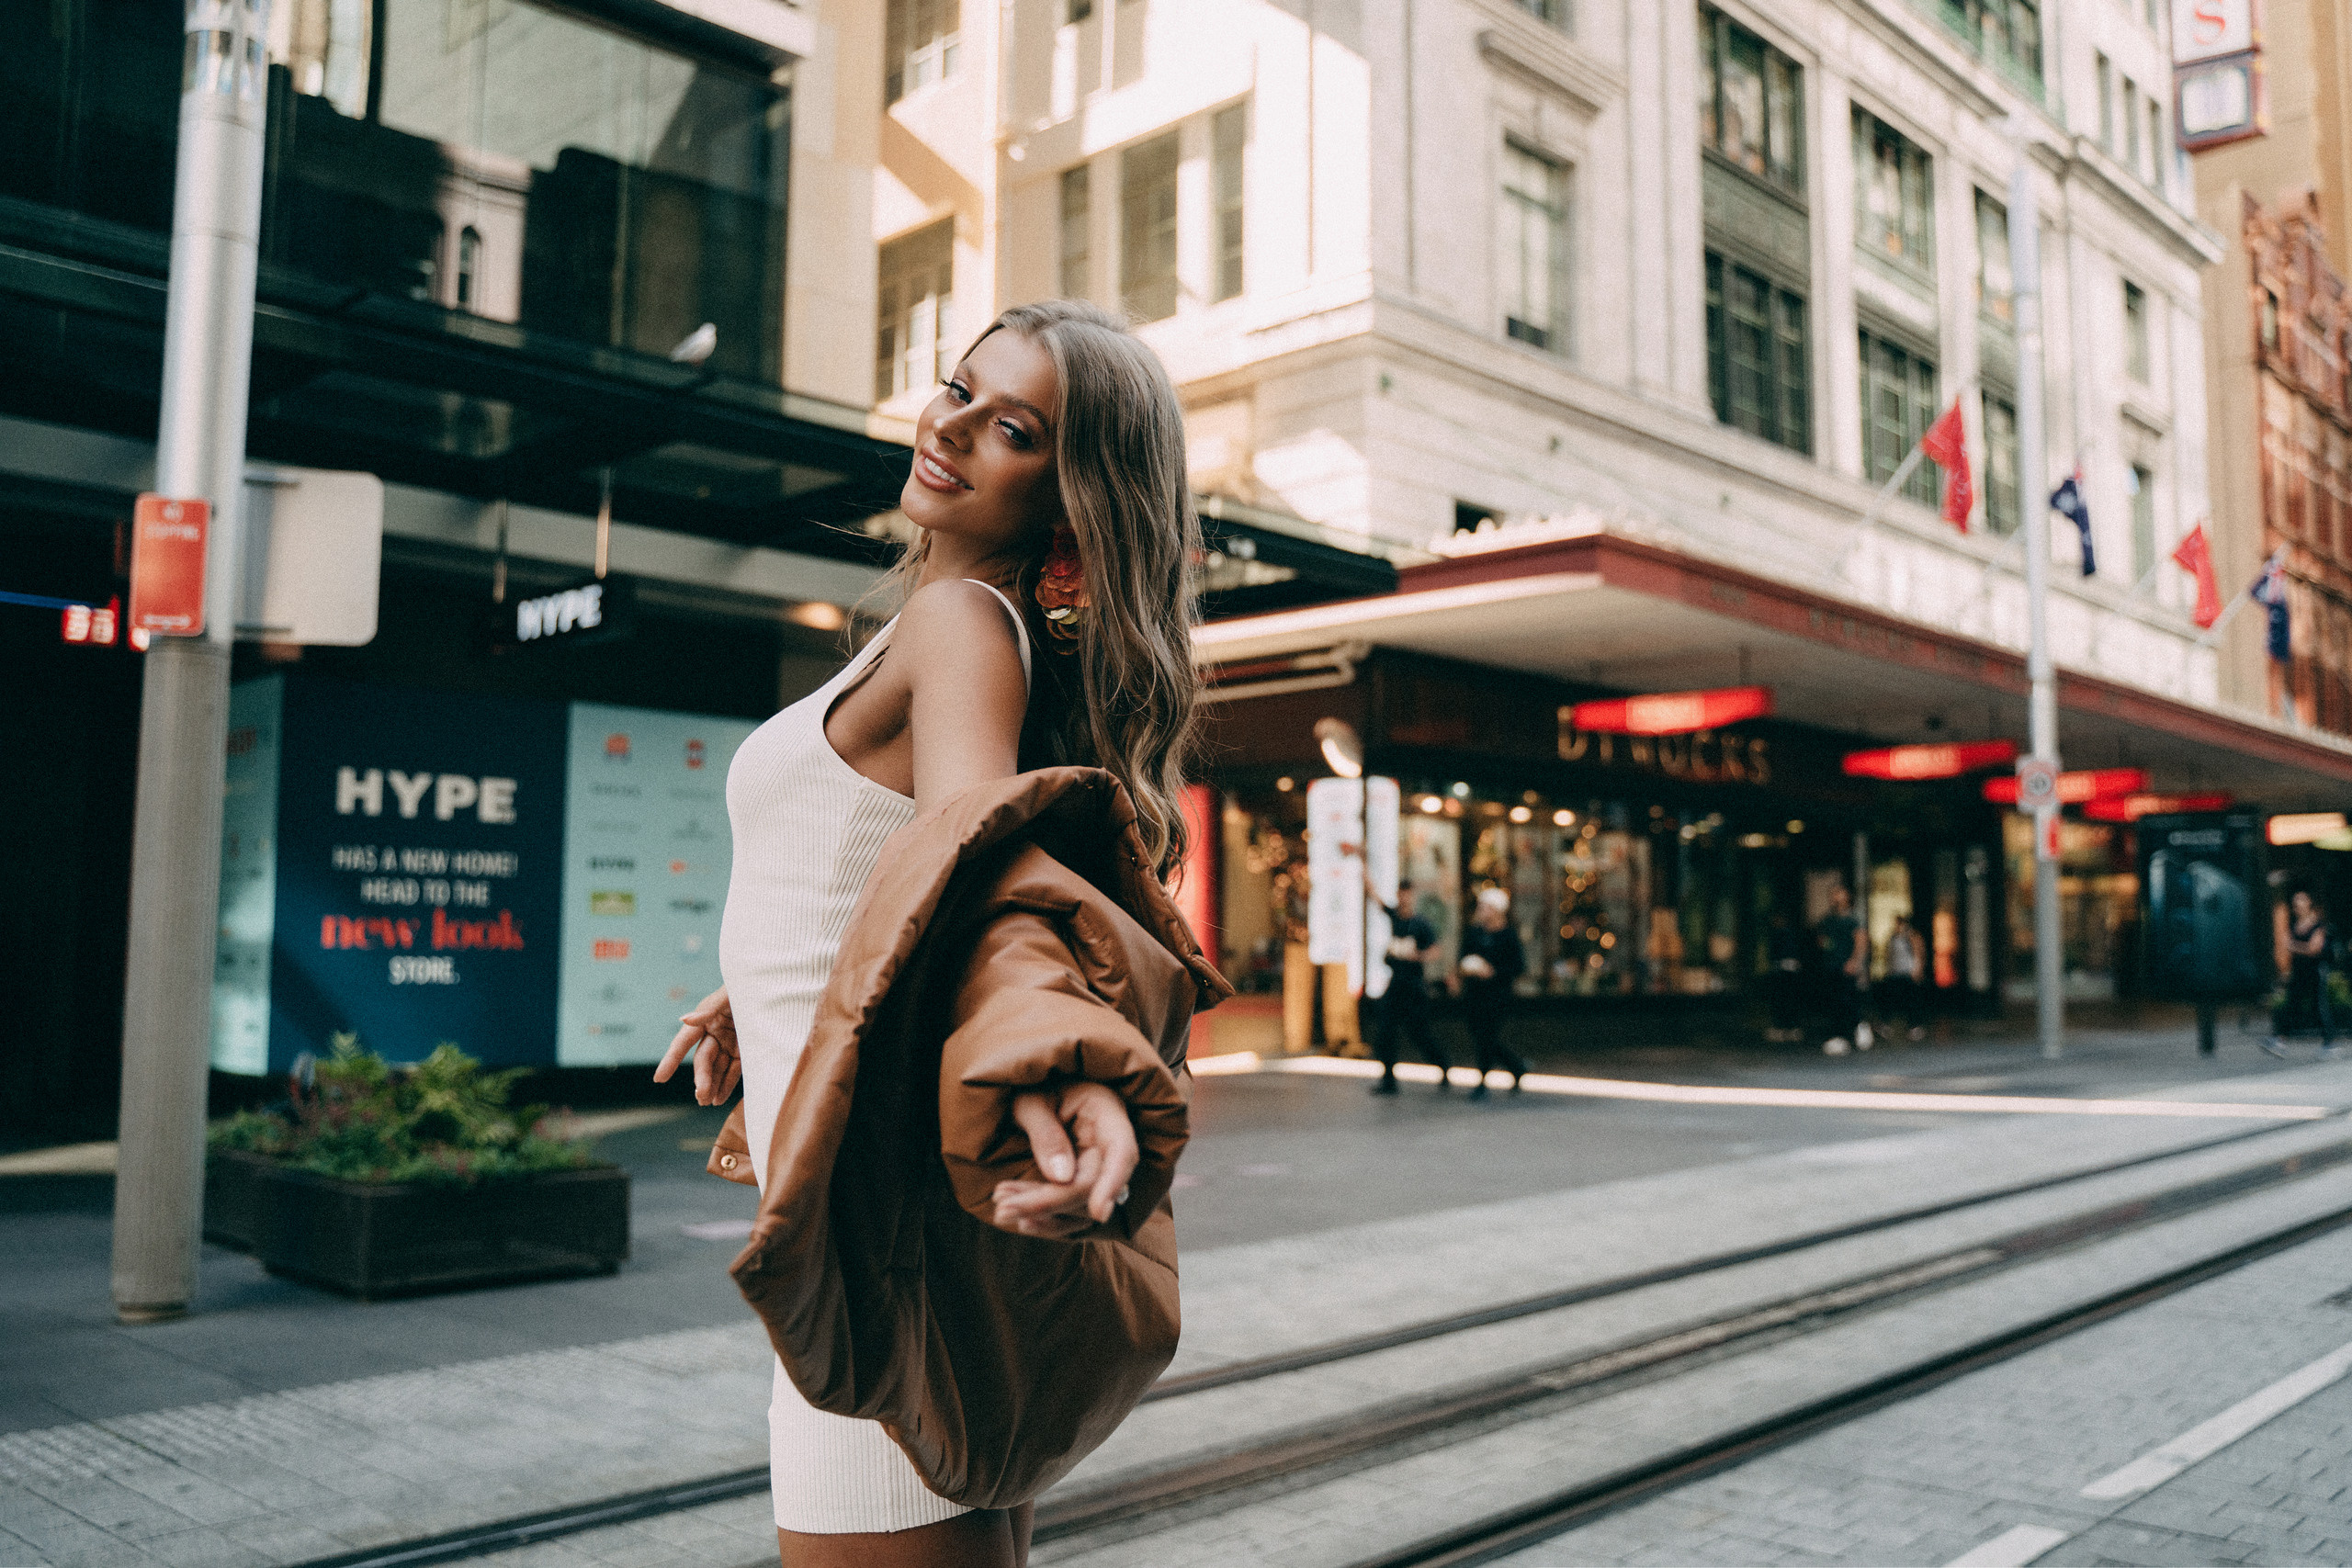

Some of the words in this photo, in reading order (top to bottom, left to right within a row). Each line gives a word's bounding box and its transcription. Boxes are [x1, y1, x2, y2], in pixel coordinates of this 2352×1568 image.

[516, 583, 604, 642] HYPE
[335, 765, 518, 824] HYPE
[331, 845, 378, 873] HAS
[379, 845, 398, 872] A
[400, 847, 450, 874] NEW
[360, 877, 420, 906] HEAD
[423, 878, 451, 906] TO
[452, 879, 491, 908] THE
[321, 914, 421, 950] new
[430, 906, 525, 951] look
